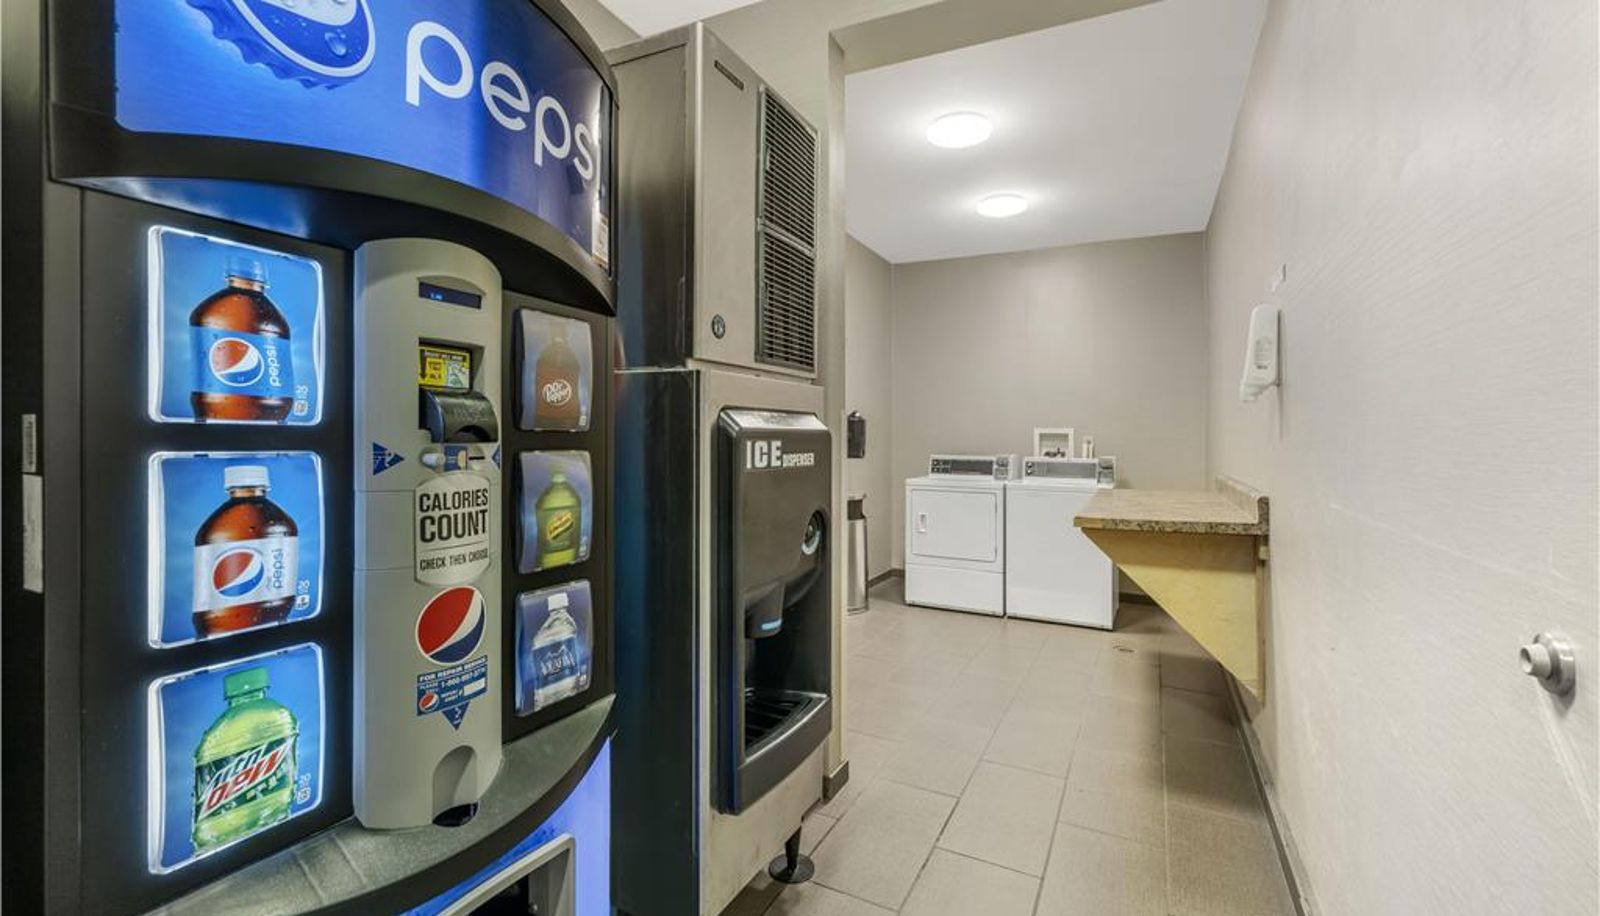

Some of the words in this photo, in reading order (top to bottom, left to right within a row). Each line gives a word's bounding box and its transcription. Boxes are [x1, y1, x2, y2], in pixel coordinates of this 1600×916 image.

[264, 344, 281, 387] pepsi
[746, 440, 782, 469] ICE
[419, 487, 488, 513] CALORIES
[420, 509, 488, 543] COUNT
[272, 548, 284, 589] pepsi
[420, 673, 436, 682] FOR
